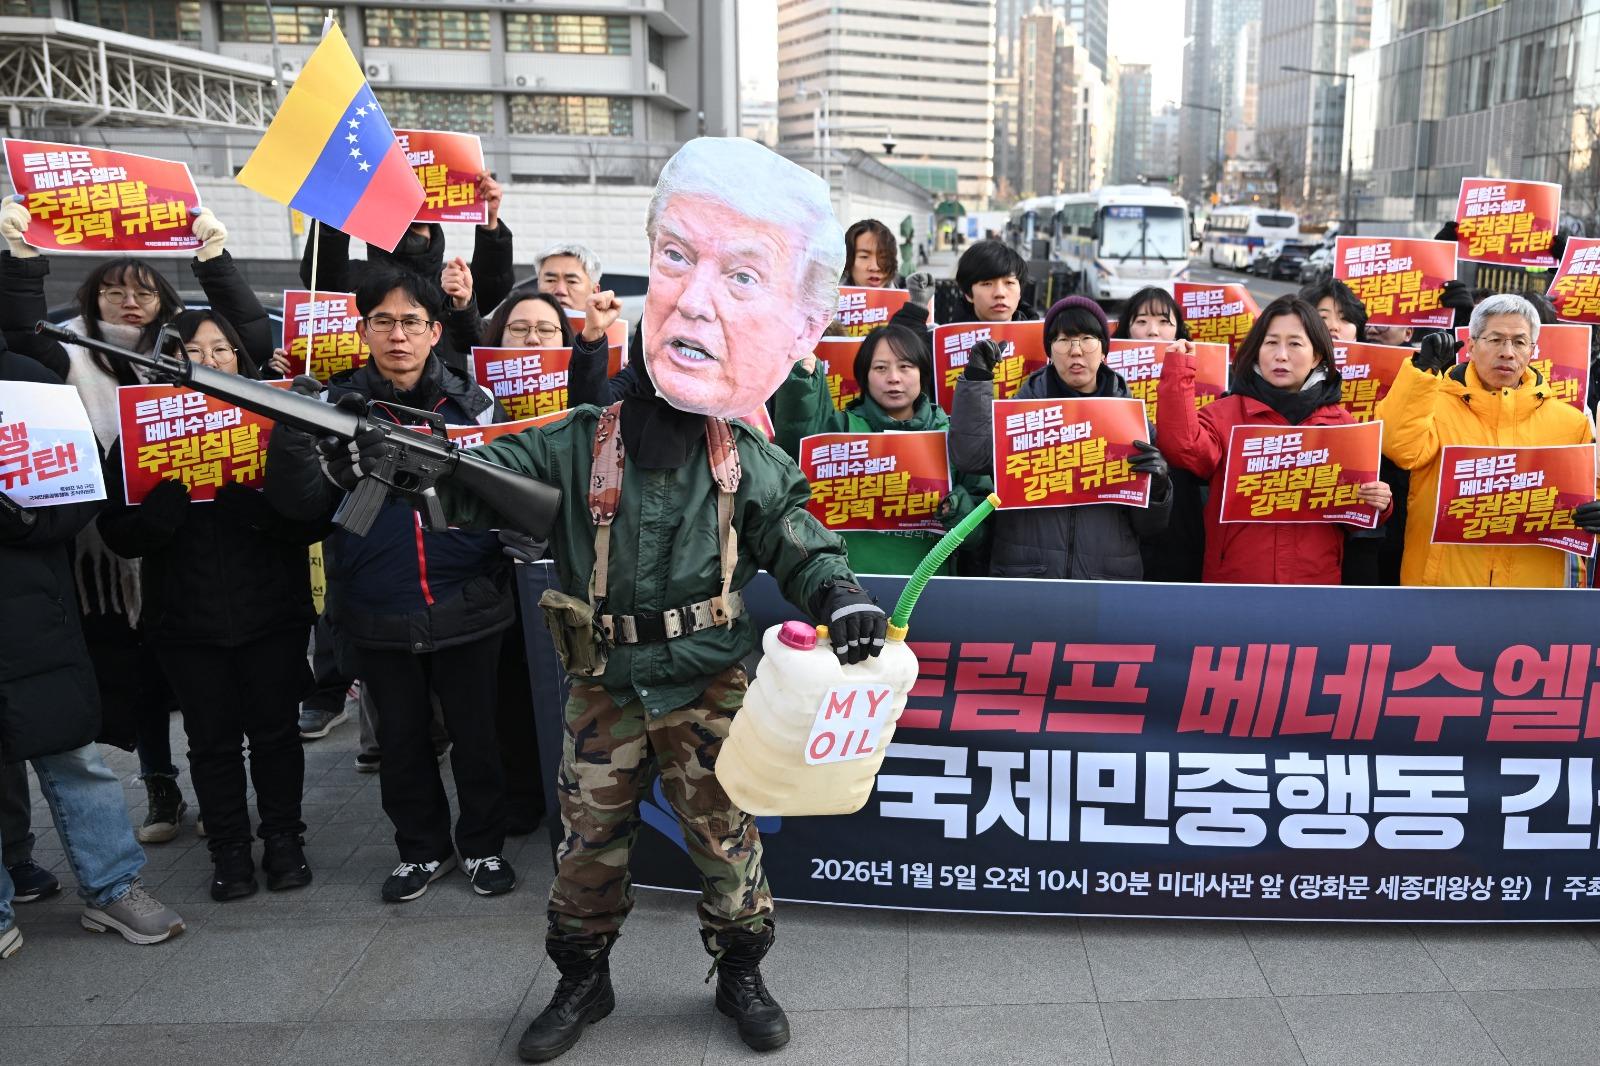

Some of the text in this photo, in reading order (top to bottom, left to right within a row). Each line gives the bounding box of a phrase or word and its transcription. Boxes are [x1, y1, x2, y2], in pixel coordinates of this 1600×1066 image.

[23, 151, 93, 172] 트럼프
[34, 167, 127, 189] 베네수엘라
[28, 181, 148, 220] 주권침탈
[425, 183, 475, 210] 규탄!
[1465, 185, 1506, 205] 트럼프
[1466, 199, 1526, 217] 베네수엘라
[53, 201, 188, 245] 강력 규탄!
[1458, 212, 1535, 238] 주권침탈
[1344, 242, 1391, 265] 트럼프
[1468, 230, 1553, 257] 강력 규탄!
[1570, 246, 1600, 264] 트럼
[1348, 256, 1413, 278] 베네수엘라
[1182, 289, 1224, 307] 트럼프
[1555, 275, 1600, 296] 주권
[835, 307, 889, 326] 네수엘라
[1186, 300, 1244, 319] 베네수엘라
[486, 354, 542, 381] 트럼프
[1106, 346, 1155, 369] 트럼프
[135, 392, 209, 424] 트럼프
[1006, 405, 1064, 435] 트럼프
[145, 407, 242, 442] 베네수엘라
[1013, 421, 1092, 451] 베네수엘라
[138, 423, 261, 473] 주권침탈
[811, 439, 869, 465] 트럼프
[1005, 436, 1108, 478] 주권침탈
[1241, 432, 1303, 457] 트럼프
[0, 442, 79, 490] 규탄!
[816, 455, 896, 479] 베네수엘라
[1247, 448, 1329, 472] 베네수엘라
[1453, 453, 1517, 480] 트럼프
[809, 471, 911, 504] 주권침탈
[1023, 468, 1073, 502] 강력
[1235, 463, 1342, 497] 주권침탈
[1459, 470, 1545, 496] 베네수엘라
[825, 497, 875, 526] 강력
[1250, 491, 1302, 517] 강력
[1448, 486, 1559, 519] 주권침탈
[1462, 508, 1583, 540] 강력 규탄
[825, 690, 890, 720] MY
[897, 641, 1600, 742] 트럼프 베네수엘
[809, 729, 874, 760] OIL
[876, 743, 1600, 850] 국제민중행동 긴
[810, 858, 893, 886] 2026년
[899, 862, 933, 889] 1월
[939, 864, 977, 890] 5일
[983, 866, 1030, 892] 오전
[1037, 868, 1088, 895] 10시
[1095, 871, 1152, 896] 30분
[1158, 871, 1254, 898] 미대사관
[1259, 873, 1284, 899] 앞
[1289, 874, 1370, 900] (광화문
[1375, 875, 1495, 901] 세종대왕상
[1500, 875, 1532, 901] 앞)
